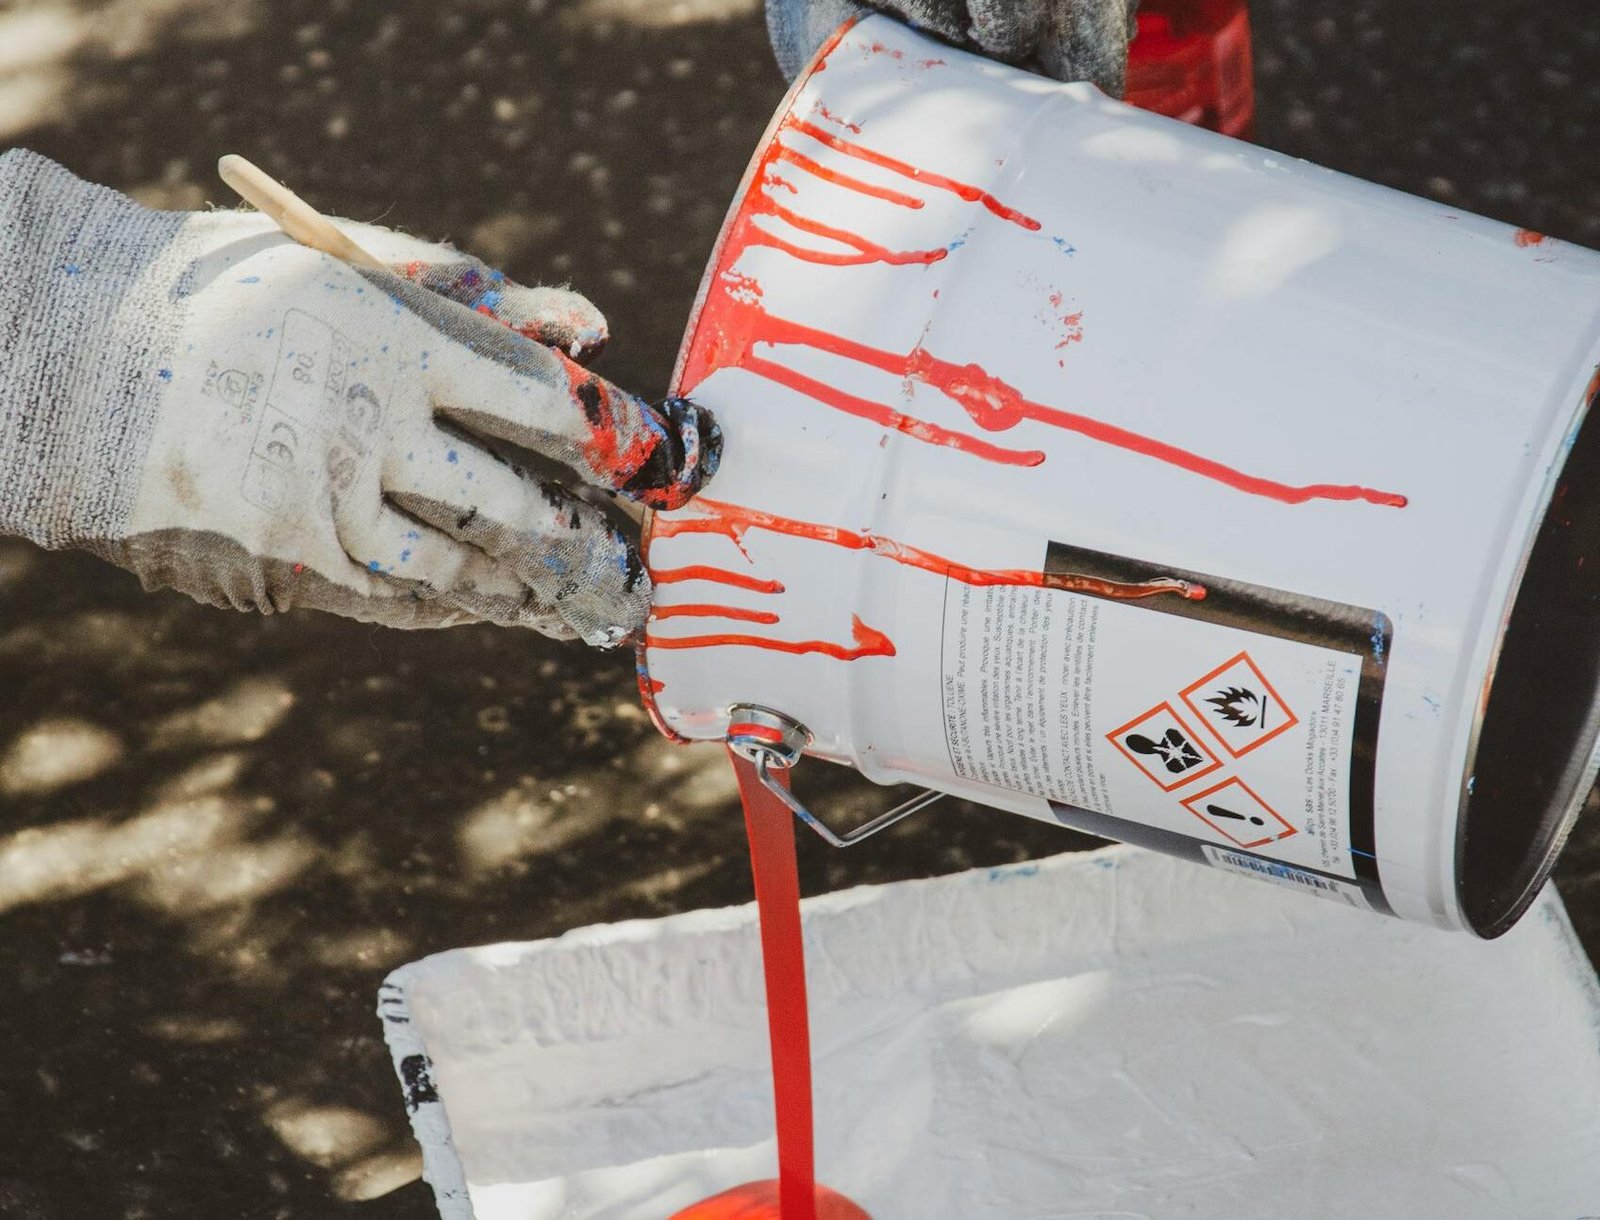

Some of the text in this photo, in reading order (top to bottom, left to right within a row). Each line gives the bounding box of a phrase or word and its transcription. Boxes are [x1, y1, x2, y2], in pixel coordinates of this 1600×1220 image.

[1032, 590, 1041, 606] des
[960, 610, 968, 625] une
[983, 616, 991, 632] une
[1029, 608, 1039, 634] Porter
[1041, 616, 1050, 631] des
[1077, 600, 1087, 632] contact
[980, 636, 991, 674] Provoque
[1039, 634, 1049, 673] protection
[1062, 642, 1071, 662] avec
[1321, 661, 1337, 714] MARSEILLE
